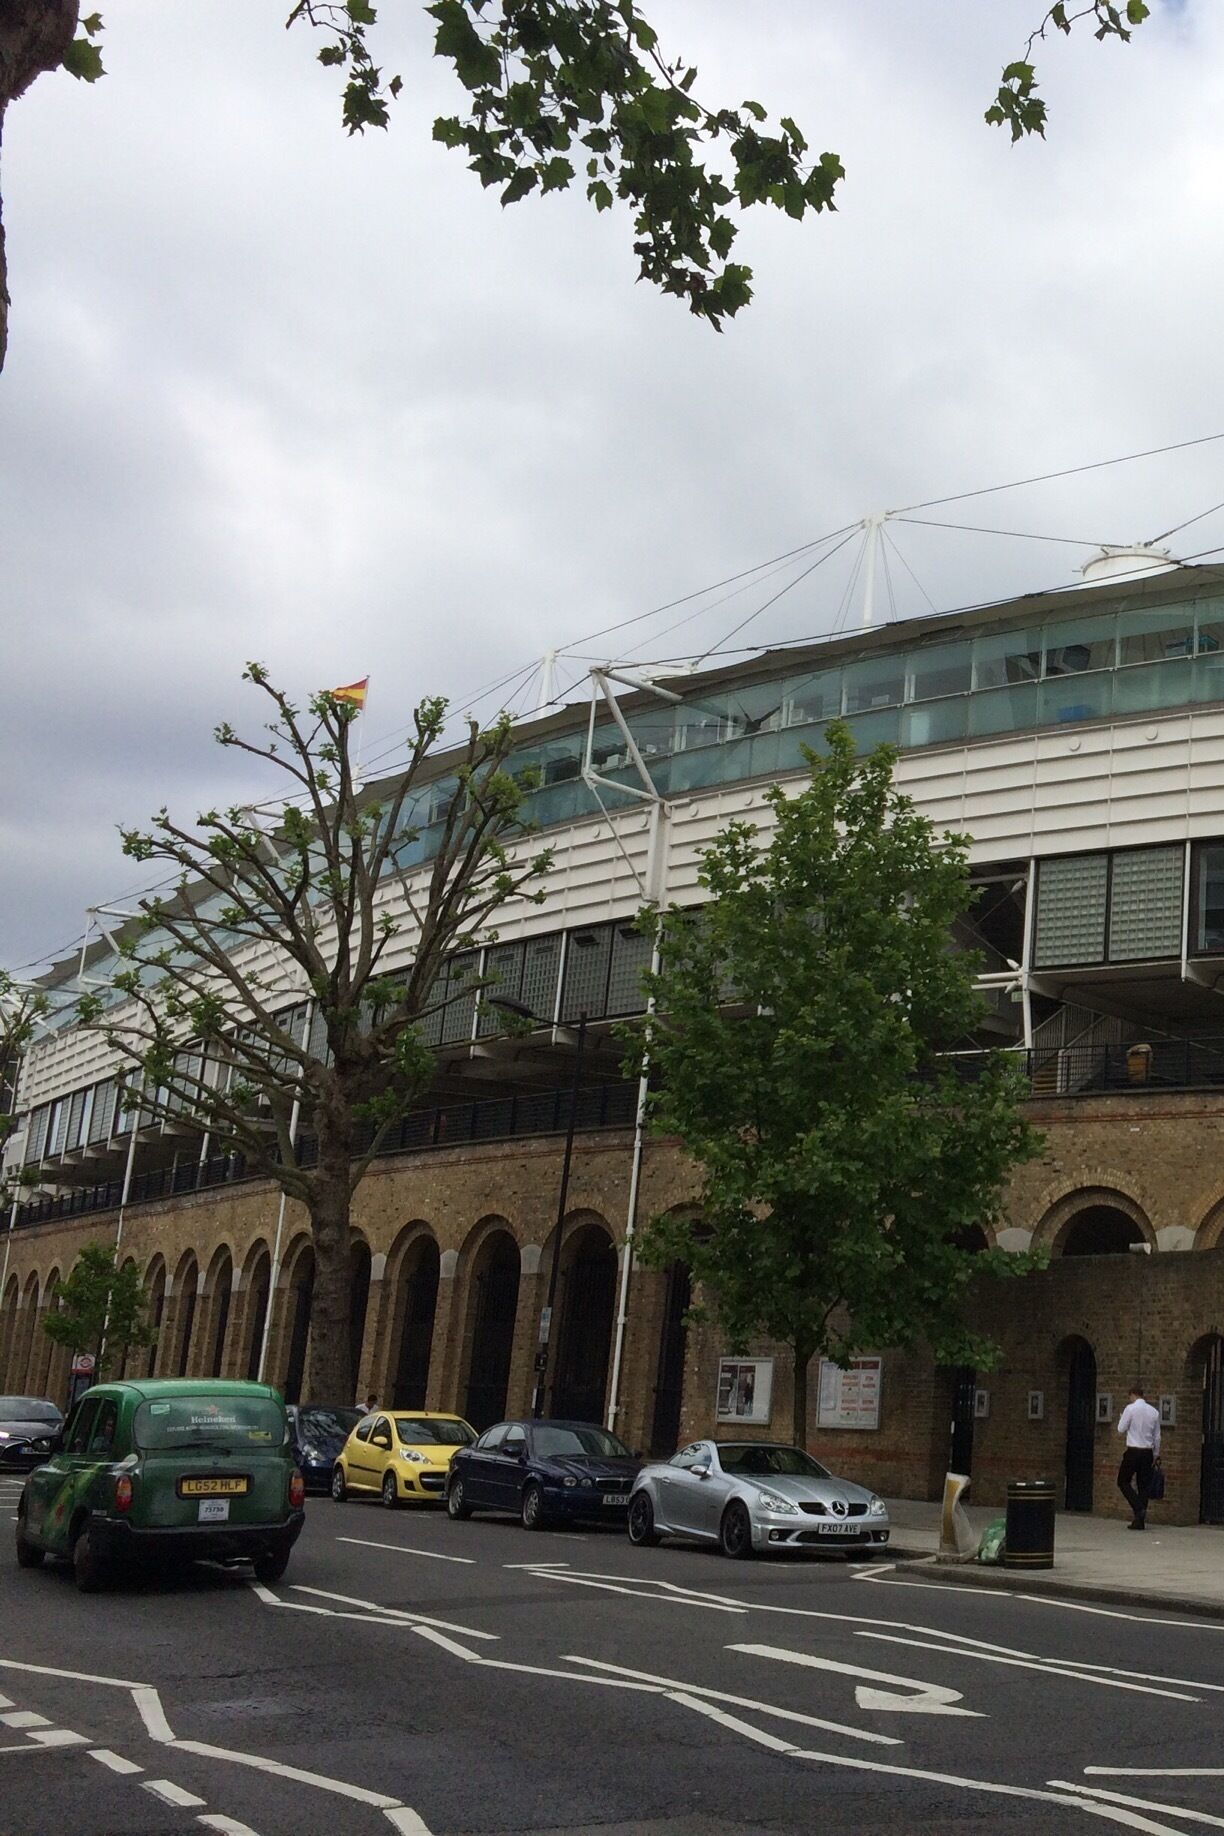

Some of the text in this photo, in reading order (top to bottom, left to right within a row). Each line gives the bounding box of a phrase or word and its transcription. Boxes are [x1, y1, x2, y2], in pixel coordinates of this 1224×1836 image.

[191, 1415, 237, 1424] Heineken
[187, 1479, 241, 1492] LG52 HLF
[822, 1523, 843, 1533] FX07
